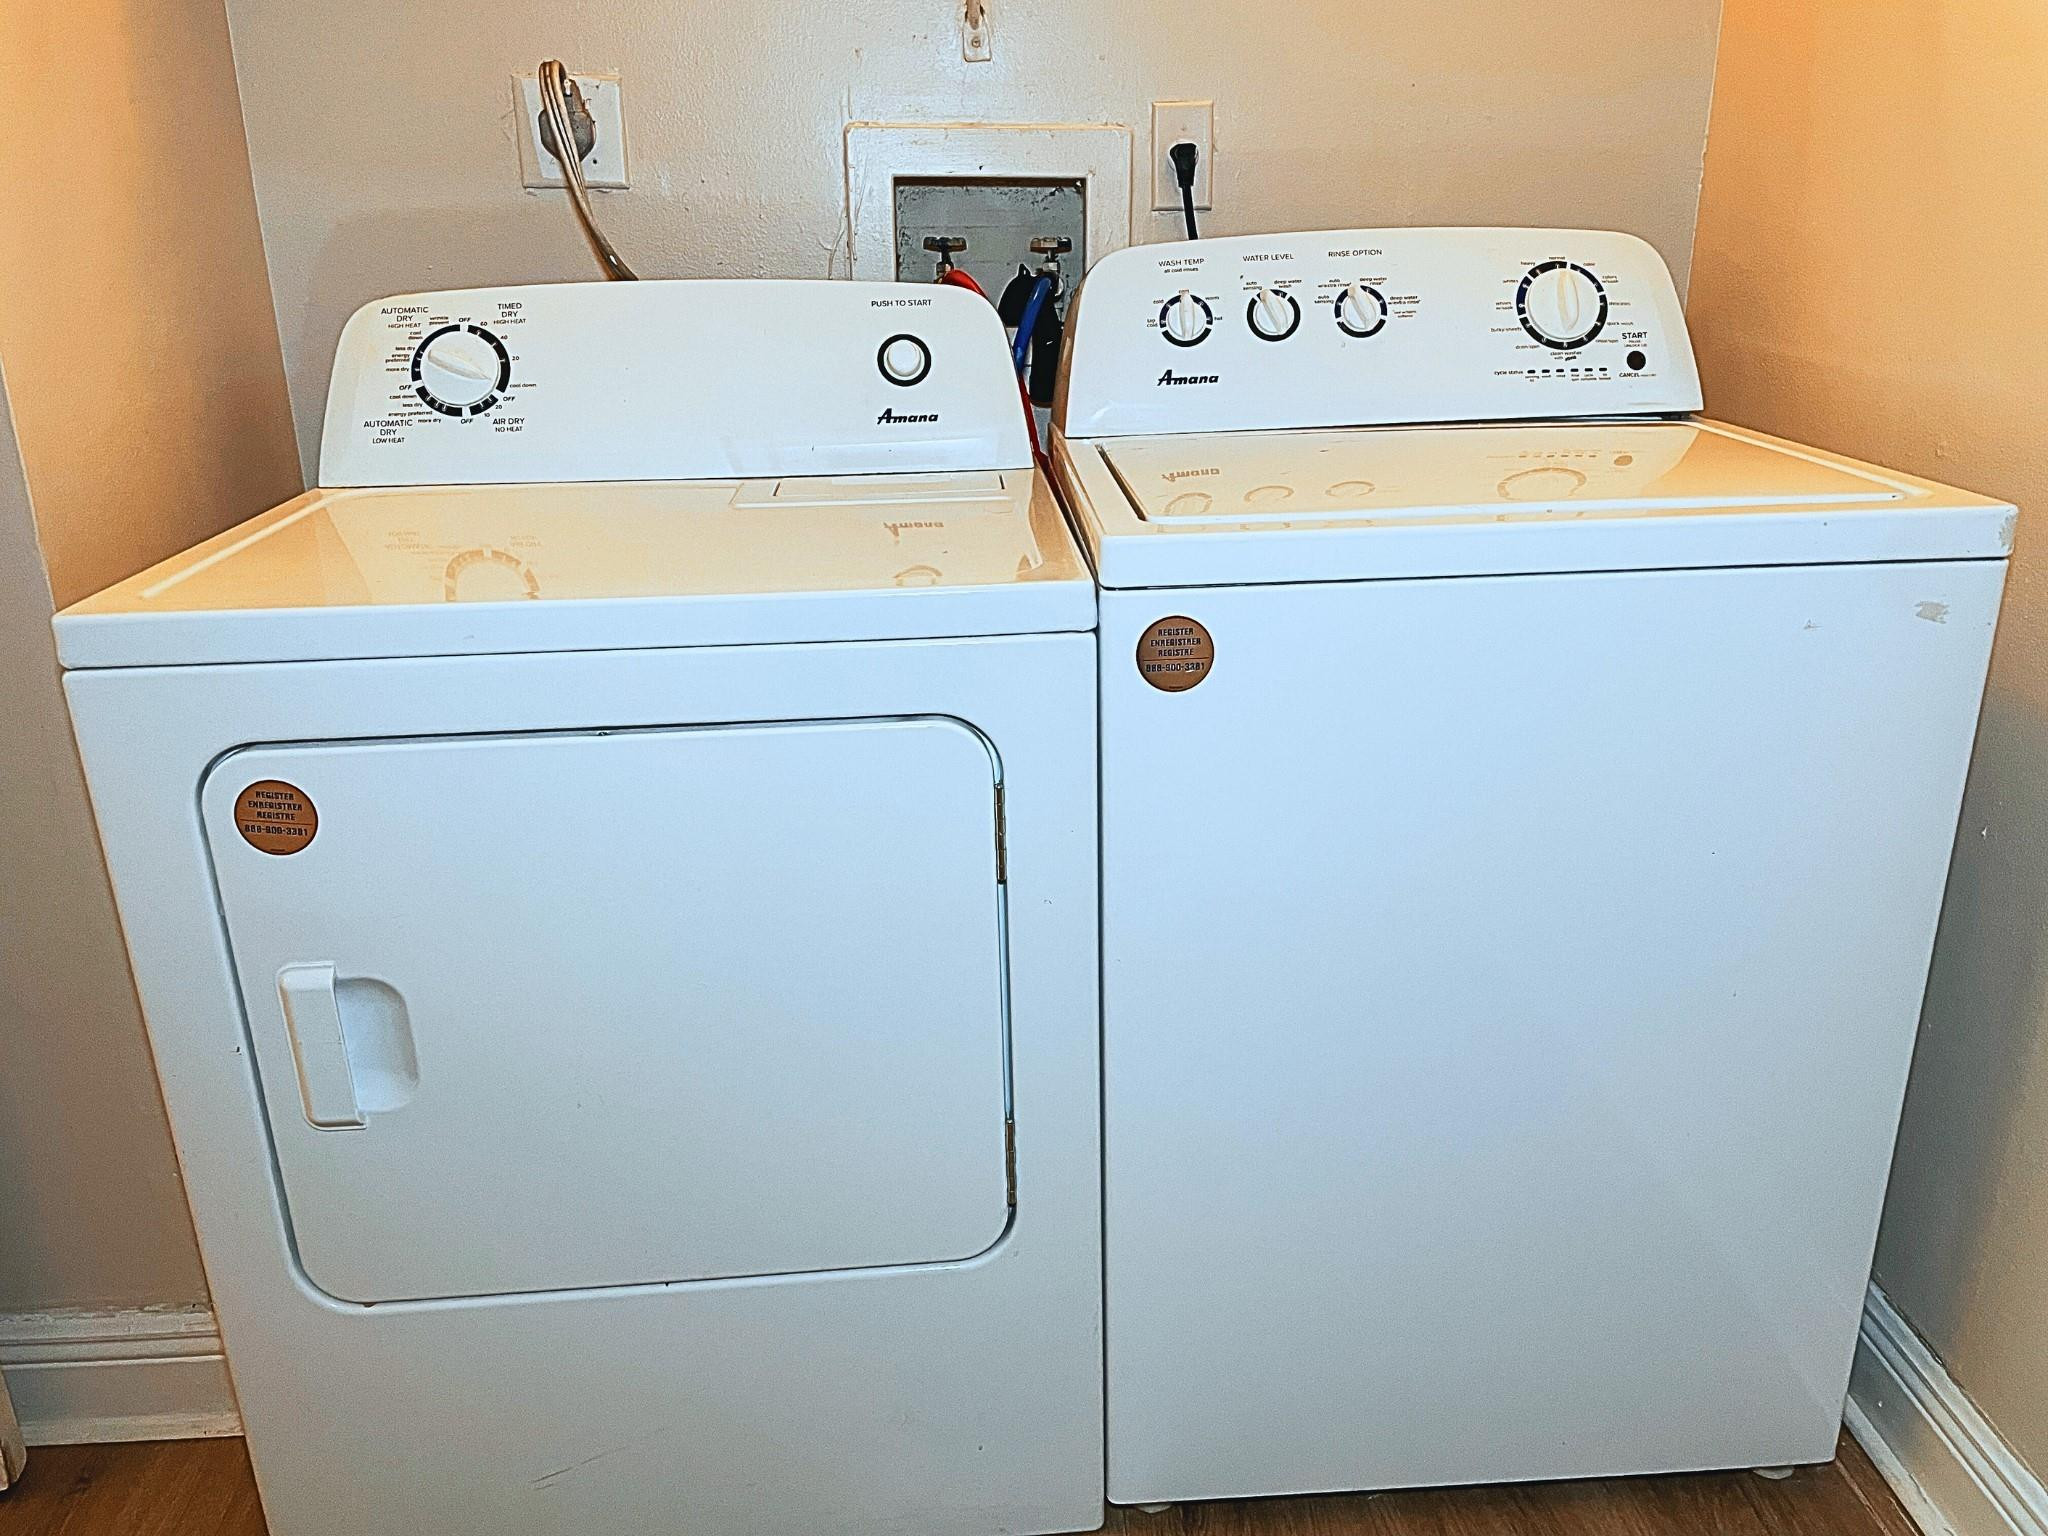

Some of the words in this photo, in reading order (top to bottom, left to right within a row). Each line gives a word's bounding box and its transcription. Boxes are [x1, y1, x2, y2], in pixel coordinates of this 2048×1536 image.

[497, 302, 522, 310] TIMED
[1622, 332, 1648, 340] START
[1157, 369, 1219, 386] Amana
[877, 408, 939, 425] Amana
[363, 420, 414, 428] AUTOMATIC
[1158, 628, 1194, 636] REGISTER
[1150, 638, 1201, 647] ENREGISTRER
[1158, 649, 1194, 657] REGISTRE
[256, 791, 294, 800] REGISTER
[248, 801, 302, 811] ENREGISTRER
[257, 811, 296, 820] REGISTRE
